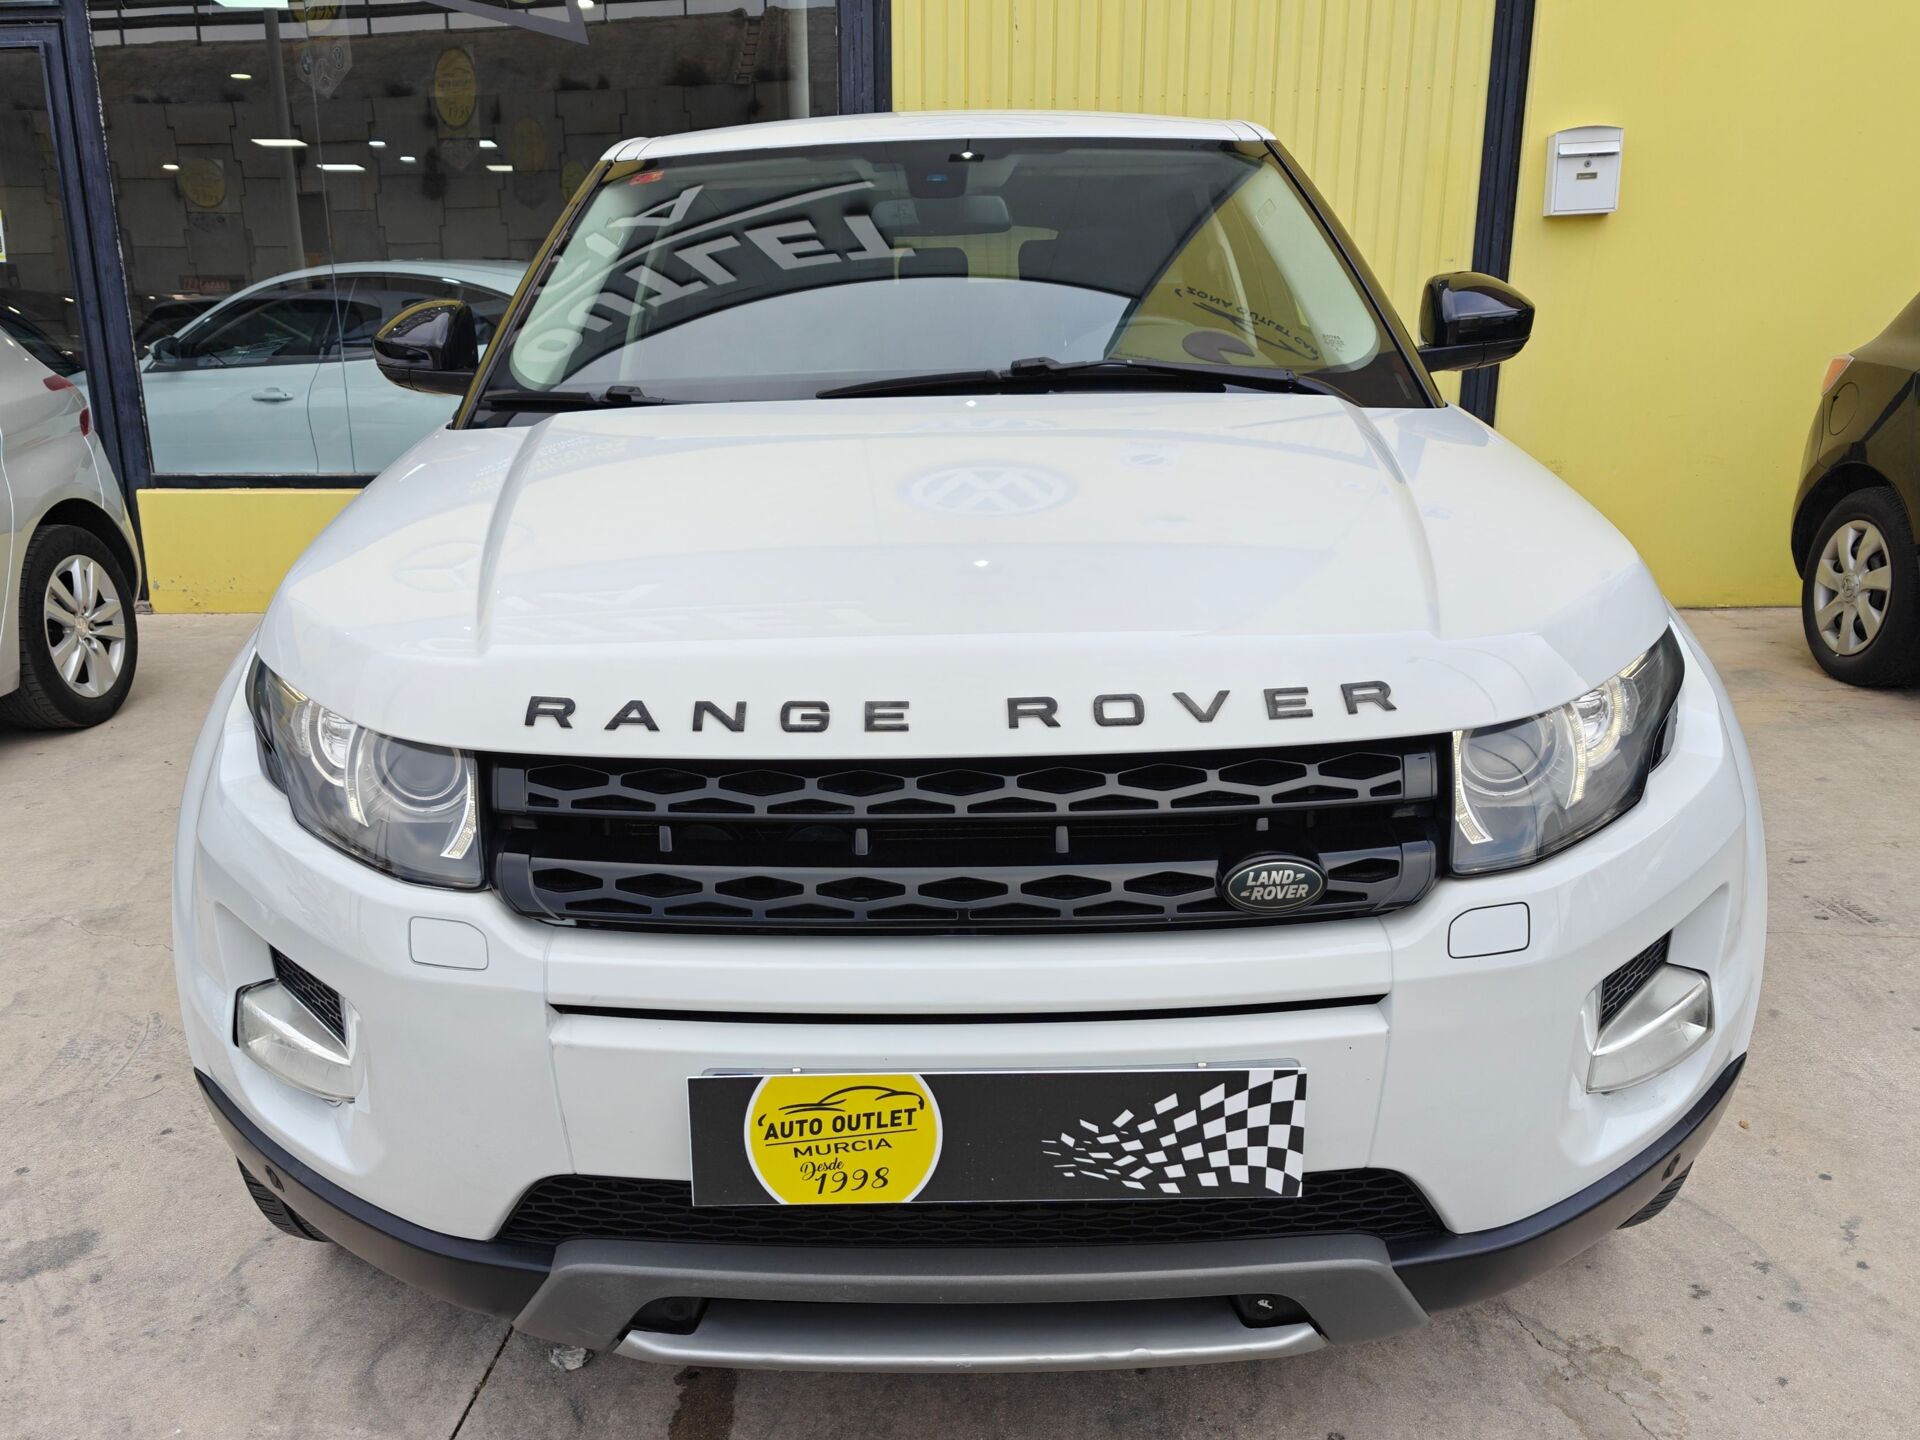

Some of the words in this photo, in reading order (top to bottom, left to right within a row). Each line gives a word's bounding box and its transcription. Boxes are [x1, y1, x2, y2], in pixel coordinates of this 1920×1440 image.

[524, 695, 910, 732] RANGE
[1007, 680, 1397, 728] ROVER
[1246, 869, 1295, 886] LAND
[1250, 884, 1309, 900] ROVER
[764, 1118, 822, 1141] AUTO
[832, 1108, 917, 1132] OUTLET
[793, 1138, 892, 1158] MURCIA
[800, 1157, 844, 1181] Desde
[814, 1167, 890, 1195] 1998
